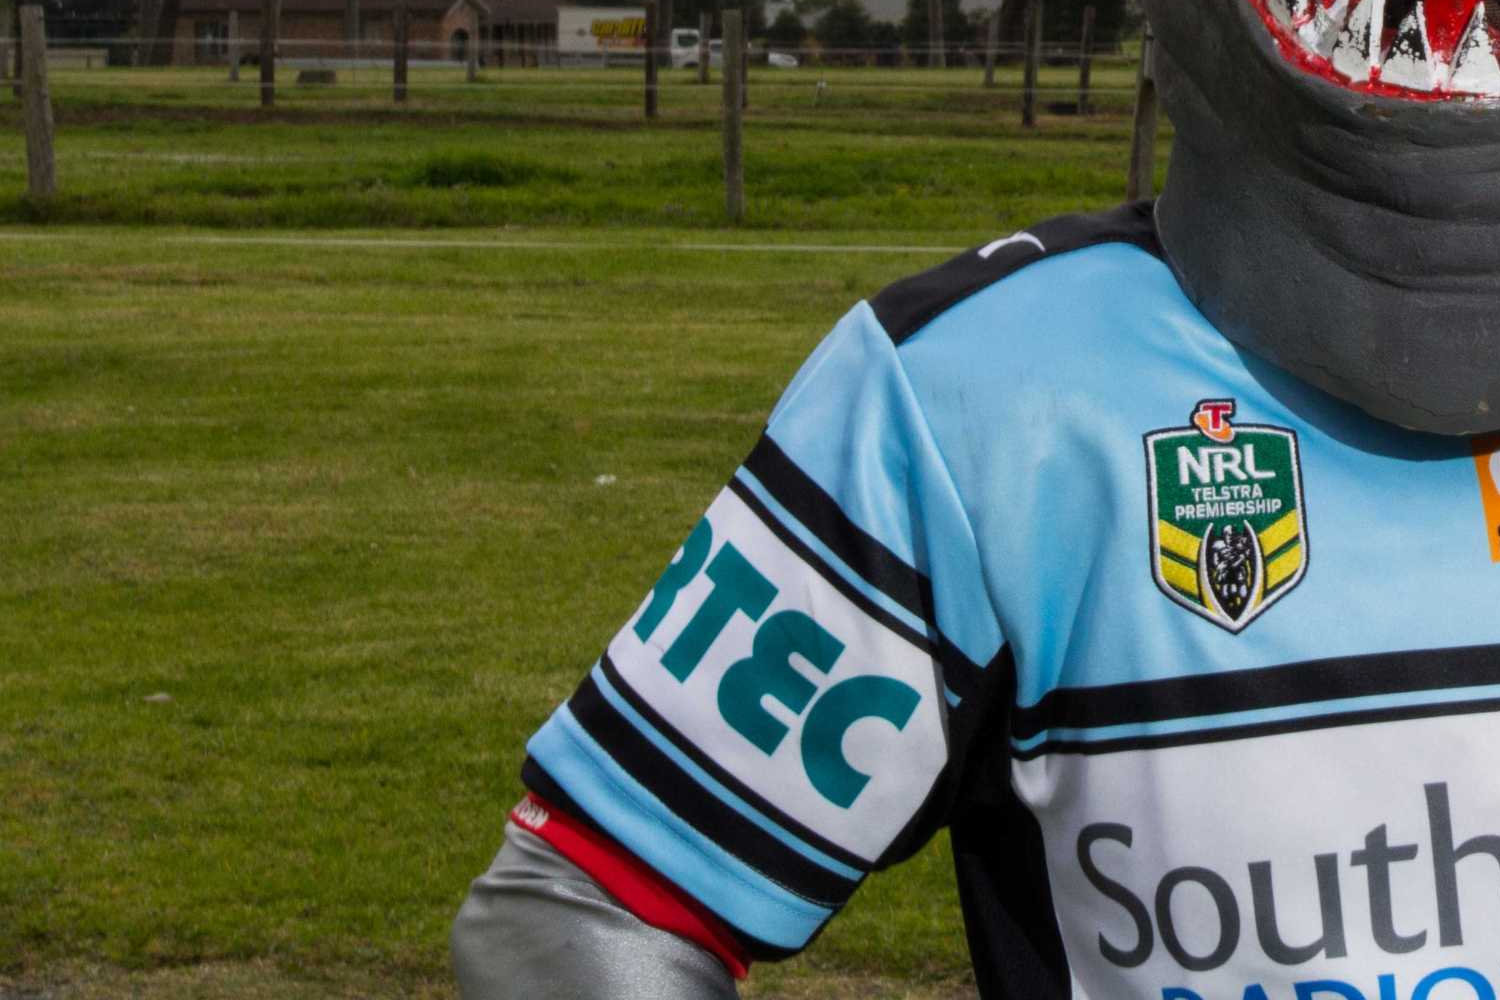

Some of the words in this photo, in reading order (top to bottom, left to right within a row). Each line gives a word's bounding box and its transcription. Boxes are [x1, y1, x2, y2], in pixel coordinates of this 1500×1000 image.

[1177, 443, 1276, 485] NRL
[1192, 484, 1263, 502] TELSTRA
[1174, 499, 1283, 521] PREMIERSHIP
